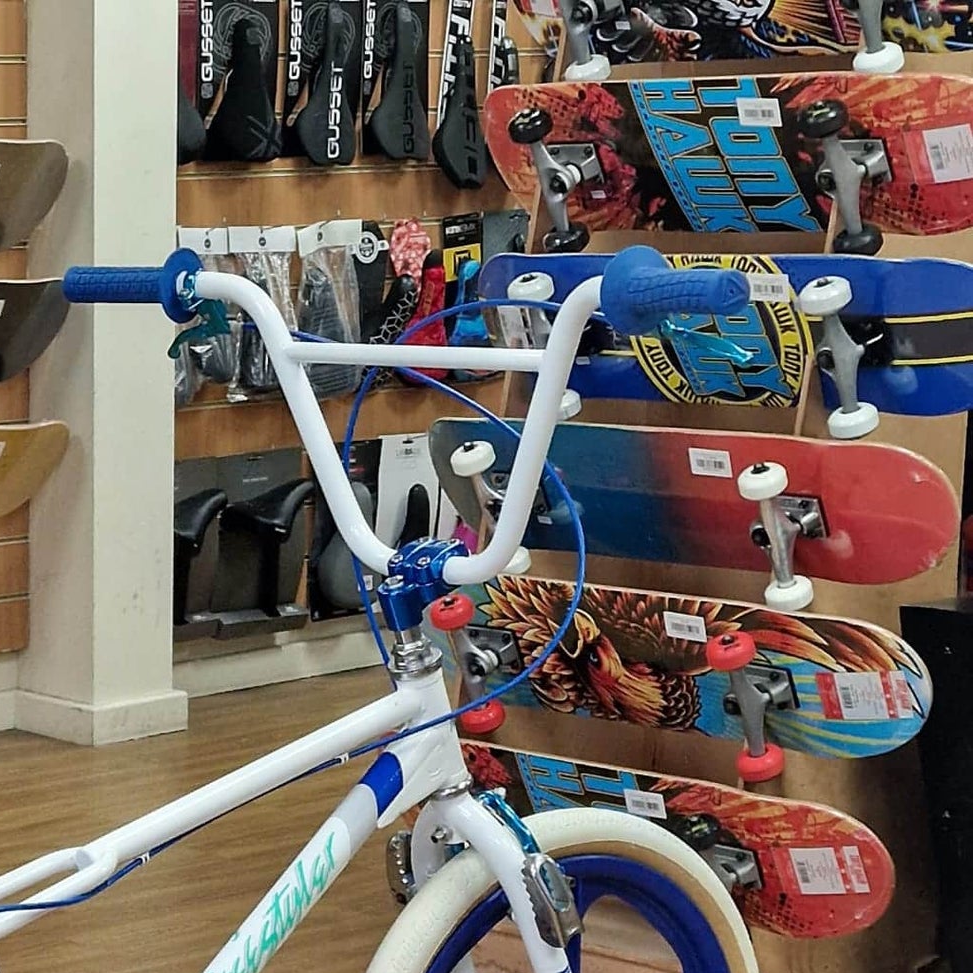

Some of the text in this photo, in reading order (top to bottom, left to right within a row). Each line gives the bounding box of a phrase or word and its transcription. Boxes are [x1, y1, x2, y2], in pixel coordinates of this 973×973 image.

[201, 0, 214, 82] GUSSET
[288, 0, 303, 80] GUSSET
[363, 0, 377, 79] GUSSET
[327, 61, 344, 159] GUSSET
[403, 61, 415, 154] GUSSET
[642, 78, 761, 233] HAWK
[698, 76, 823, 233] TONY
[645, 343, 675, 381] TONY
